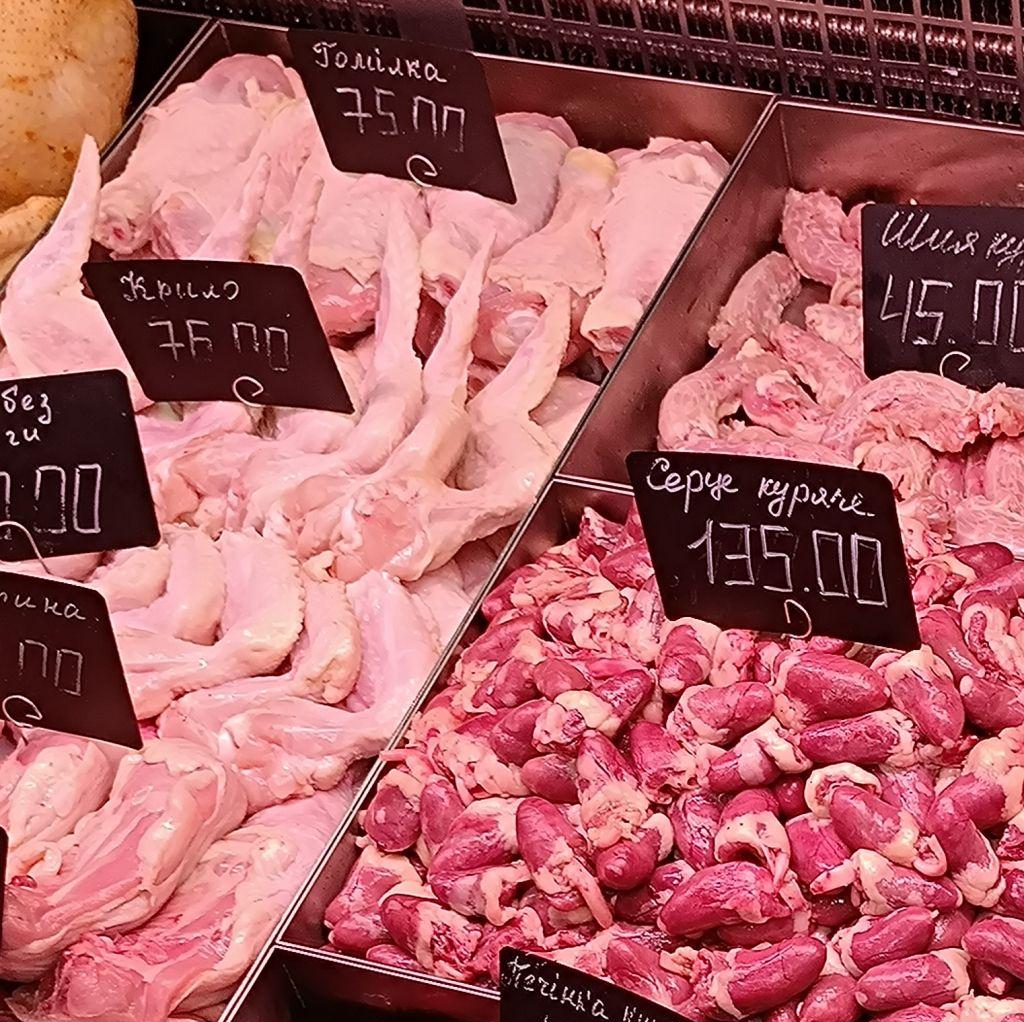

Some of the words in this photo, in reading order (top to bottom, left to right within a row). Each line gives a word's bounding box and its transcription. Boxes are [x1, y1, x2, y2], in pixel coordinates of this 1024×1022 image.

[312, 41, 448, 83] Гомілка
[120, 270, 240, 303] Крило
[1, 384, 52, 424] без
[646, 457, 739, 513] Серце
[687, 518, 888, 608] 135.00
